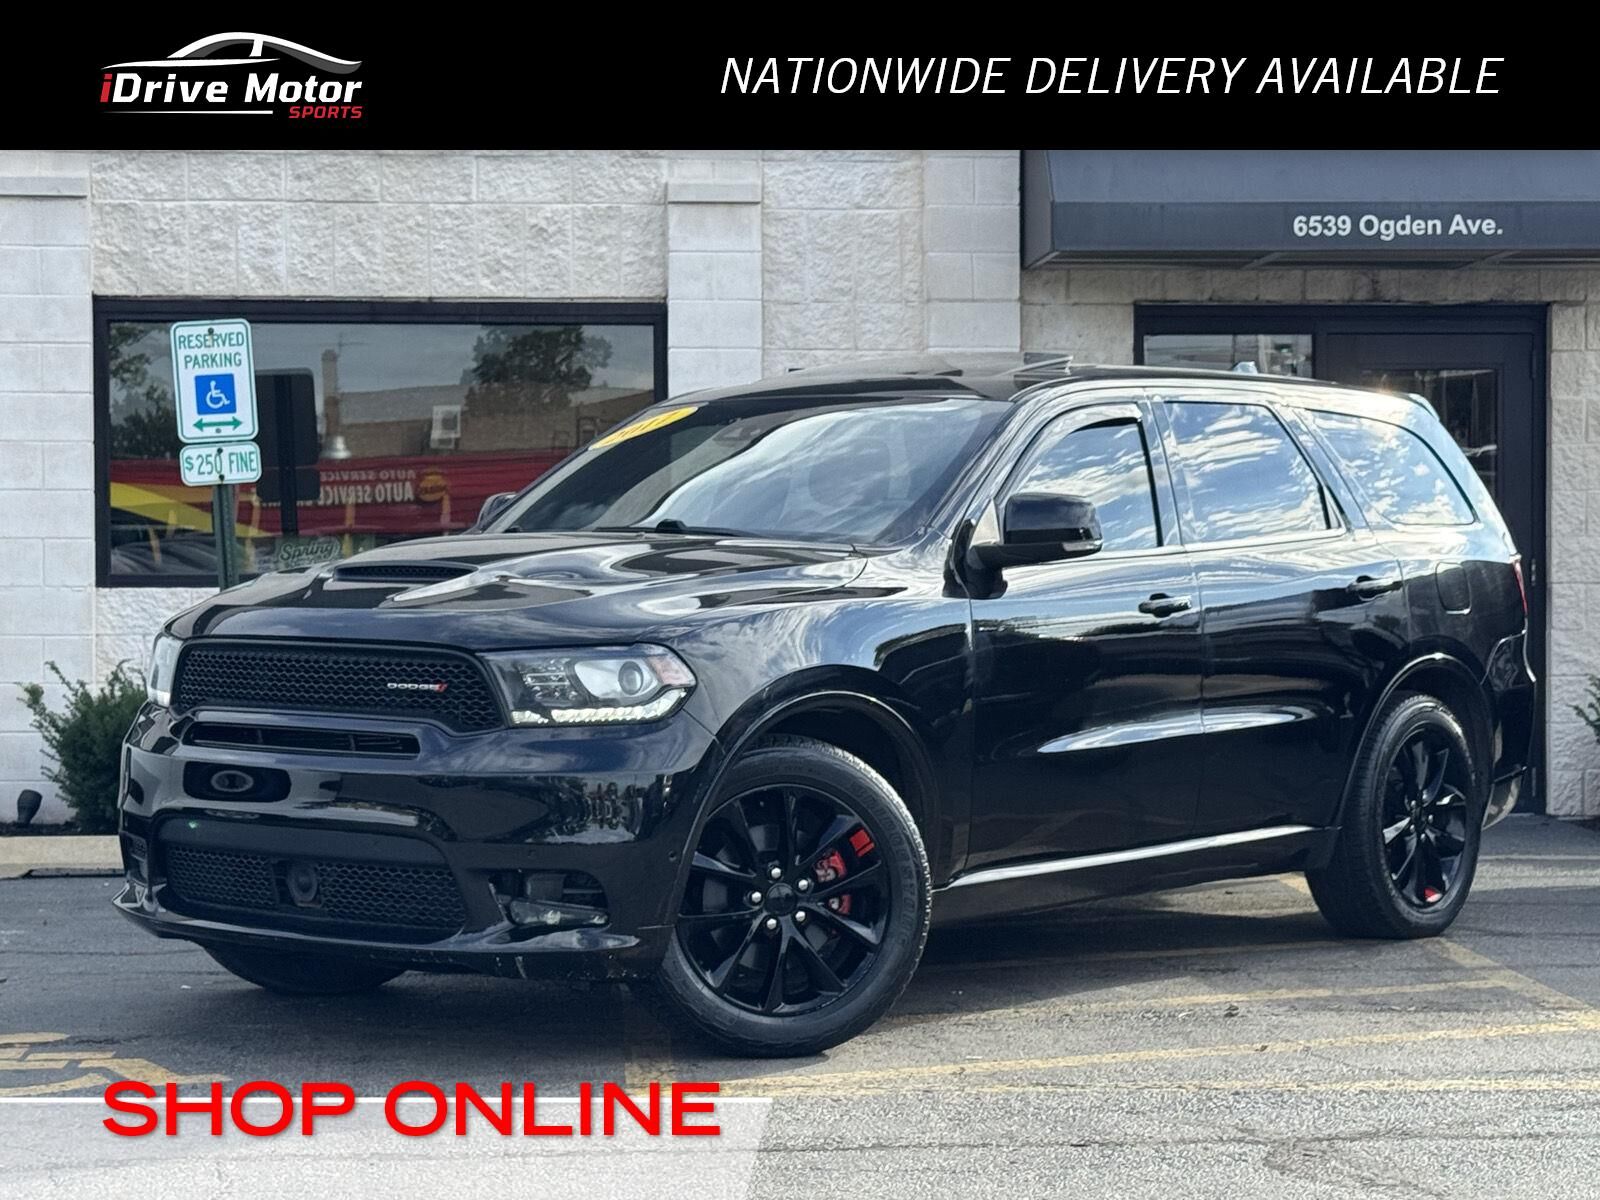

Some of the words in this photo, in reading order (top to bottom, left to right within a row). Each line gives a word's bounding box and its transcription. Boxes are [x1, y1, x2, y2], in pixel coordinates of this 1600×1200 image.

[1292, 214, 1352, 237] 6539
[1359, 214, 1442, 241] Ogden
[1448, 214, 1503, 236] Ave.
[178, 332, 245, 350] RESERVED
[184, 352, 242, 370] PARKING
[185, 452, 223, 476] $250
[228, 451, 257, 475] FINE
[387, 682, 438, 691] DODGE
